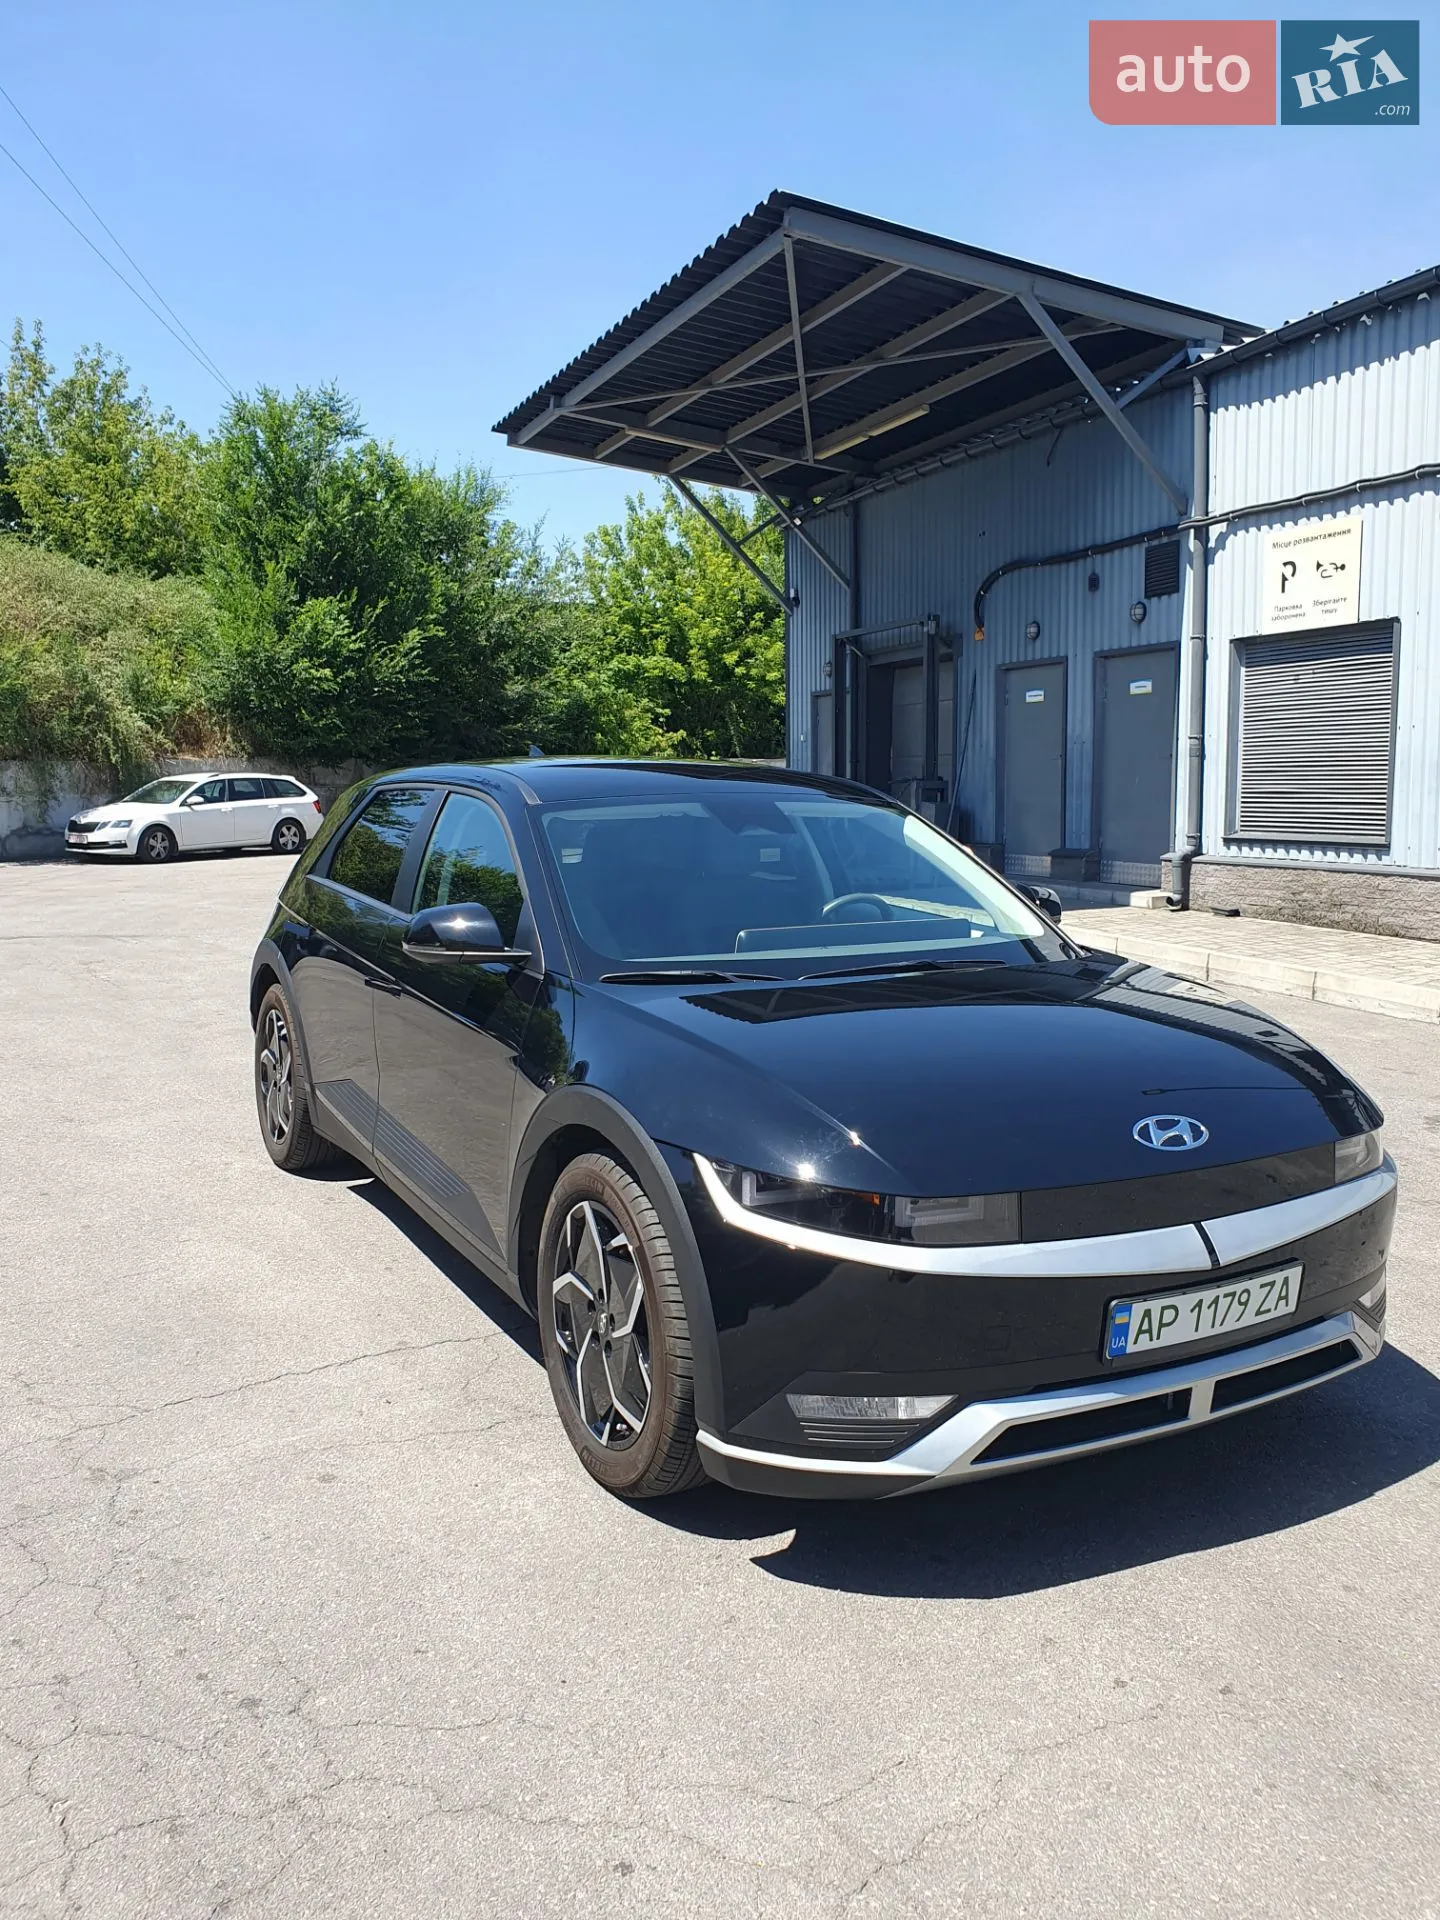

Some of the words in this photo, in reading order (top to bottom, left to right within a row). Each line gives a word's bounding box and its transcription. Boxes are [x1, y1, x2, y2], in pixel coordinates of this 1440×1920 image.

[1272, 541, 1292, 549] Місце
[1293, 528, 1352, 546] розвантаження
[1133, 1304, 1179, 1345] AP
[1190, 1288, 1252, 1333] 1179
[1254, 1275, 1290, 1317] ZA
[1111, 1337, 1125, 1348] UA
